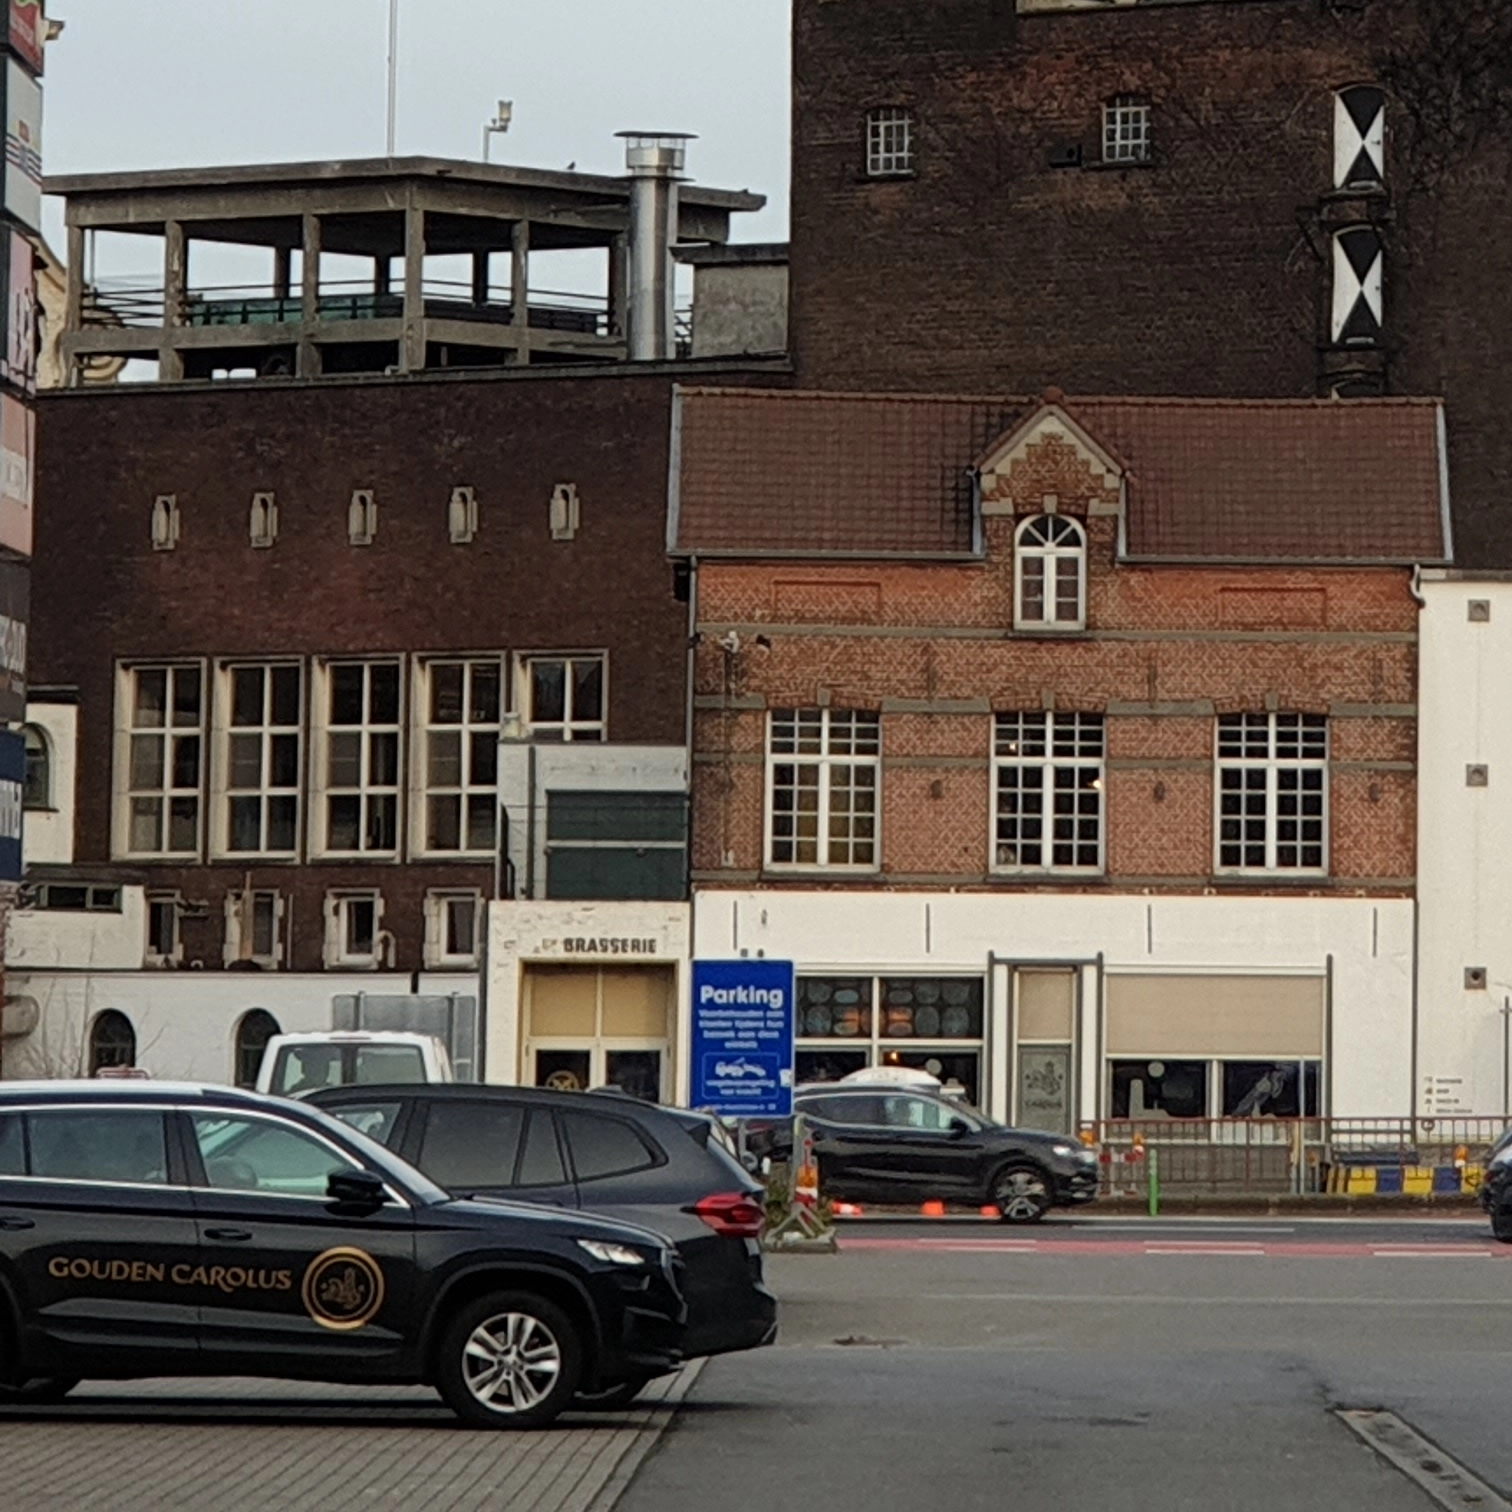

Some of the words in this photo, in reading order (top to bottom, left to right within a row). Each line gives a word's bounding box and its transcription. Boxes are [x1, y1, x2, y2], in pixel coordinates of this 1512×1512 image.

[563, 937, 657, 954] BRASSERIE
[700, 985, 784, 1009] Parking
[48, 1256, 166, 1283] GOUDEN
[170, 1263, 293, 1293] CAROLUS
